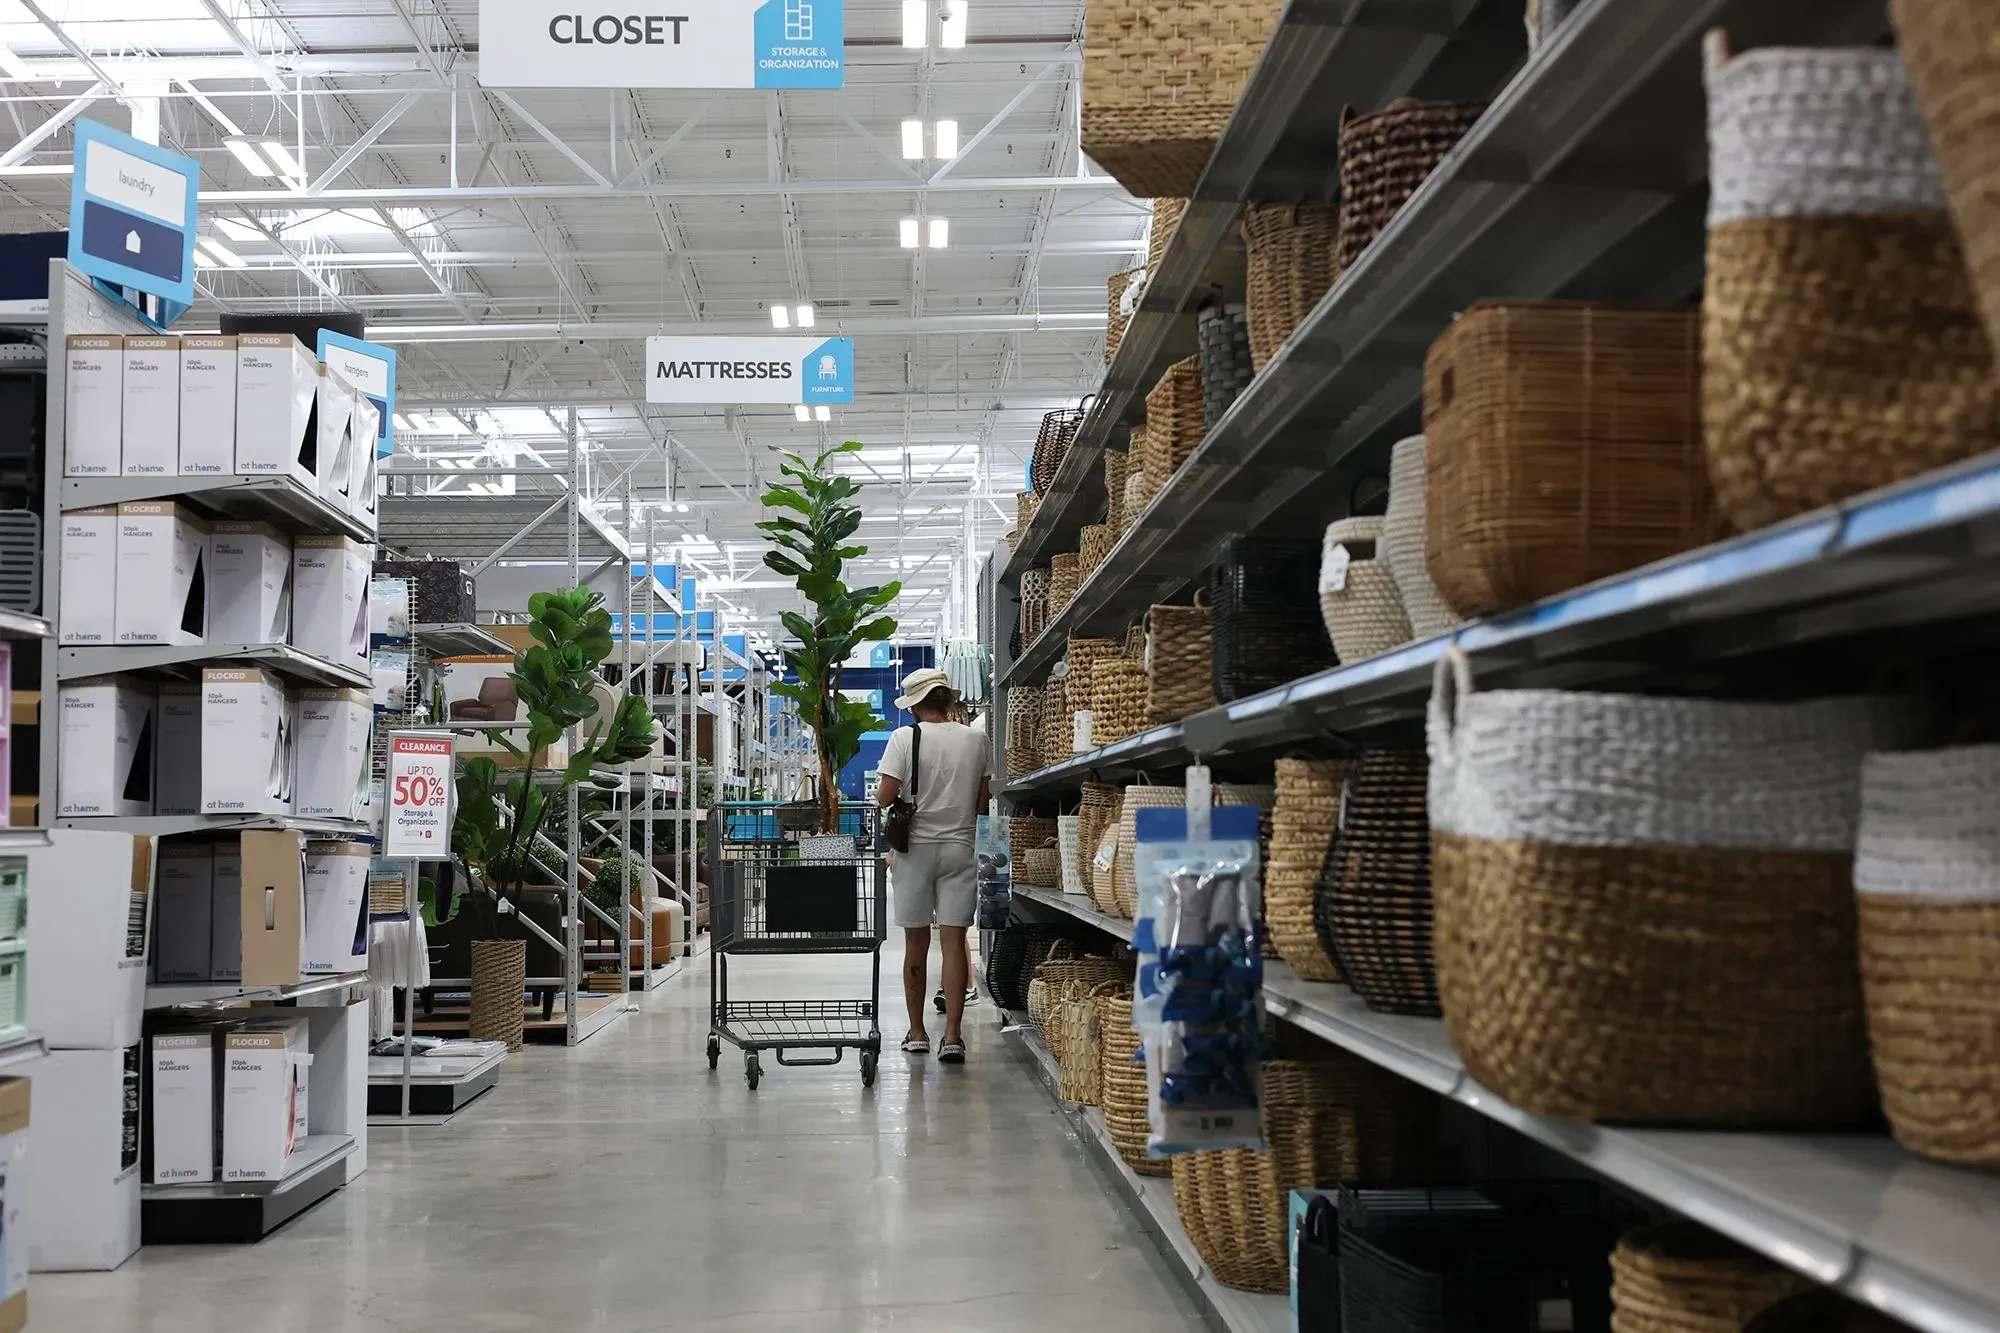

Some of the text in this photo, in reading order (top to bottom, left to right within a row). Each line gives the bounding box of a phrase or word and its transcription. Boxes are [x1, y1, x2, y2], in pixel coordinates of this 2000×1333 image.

[549, 14, 689, 44] CLOSET
[771, 48, 827, 56] STORAGE &
[759, 59, 839, 69] ORGANIZATION
[118, 167, 155, 198] laundry
[72, 340, 110, 348] FLOCKED
[344, 362, 369, 378] hangers
[656, 361, 792, 379] MATTRESSES
[70, 463, 107, 473] at home
[128, 464, 164, 473] at home
[184, 462, 221, 472] at home
[240, 460, 278, 470] at home
[76, 632, 102, 640] home
[132, 632, 158, 640] home
[208, 672, 246, 680] FLOCKED
[400, 742, 446, 752] CLEARANCE
[407, 766, 434, 776] UP TO
[394, 776, 444, 806] 50%
[218, 800, 244, 808] home
[428, 797, 445, 807] OFF
[74, 804, 100, 812] home
[310, 806, 334, 814] home
[404, 810, 428, 818] Storage
[398, 818, 438, 826] Organization
[310, 960, 333, 969] home
[158, 1038, 198, 1046] FLOCKED
[231, 1038, 270, 1046] FLOCKED
[160, 1168, 198, 1178] at home
[240, 1168, 266, 1178] home
